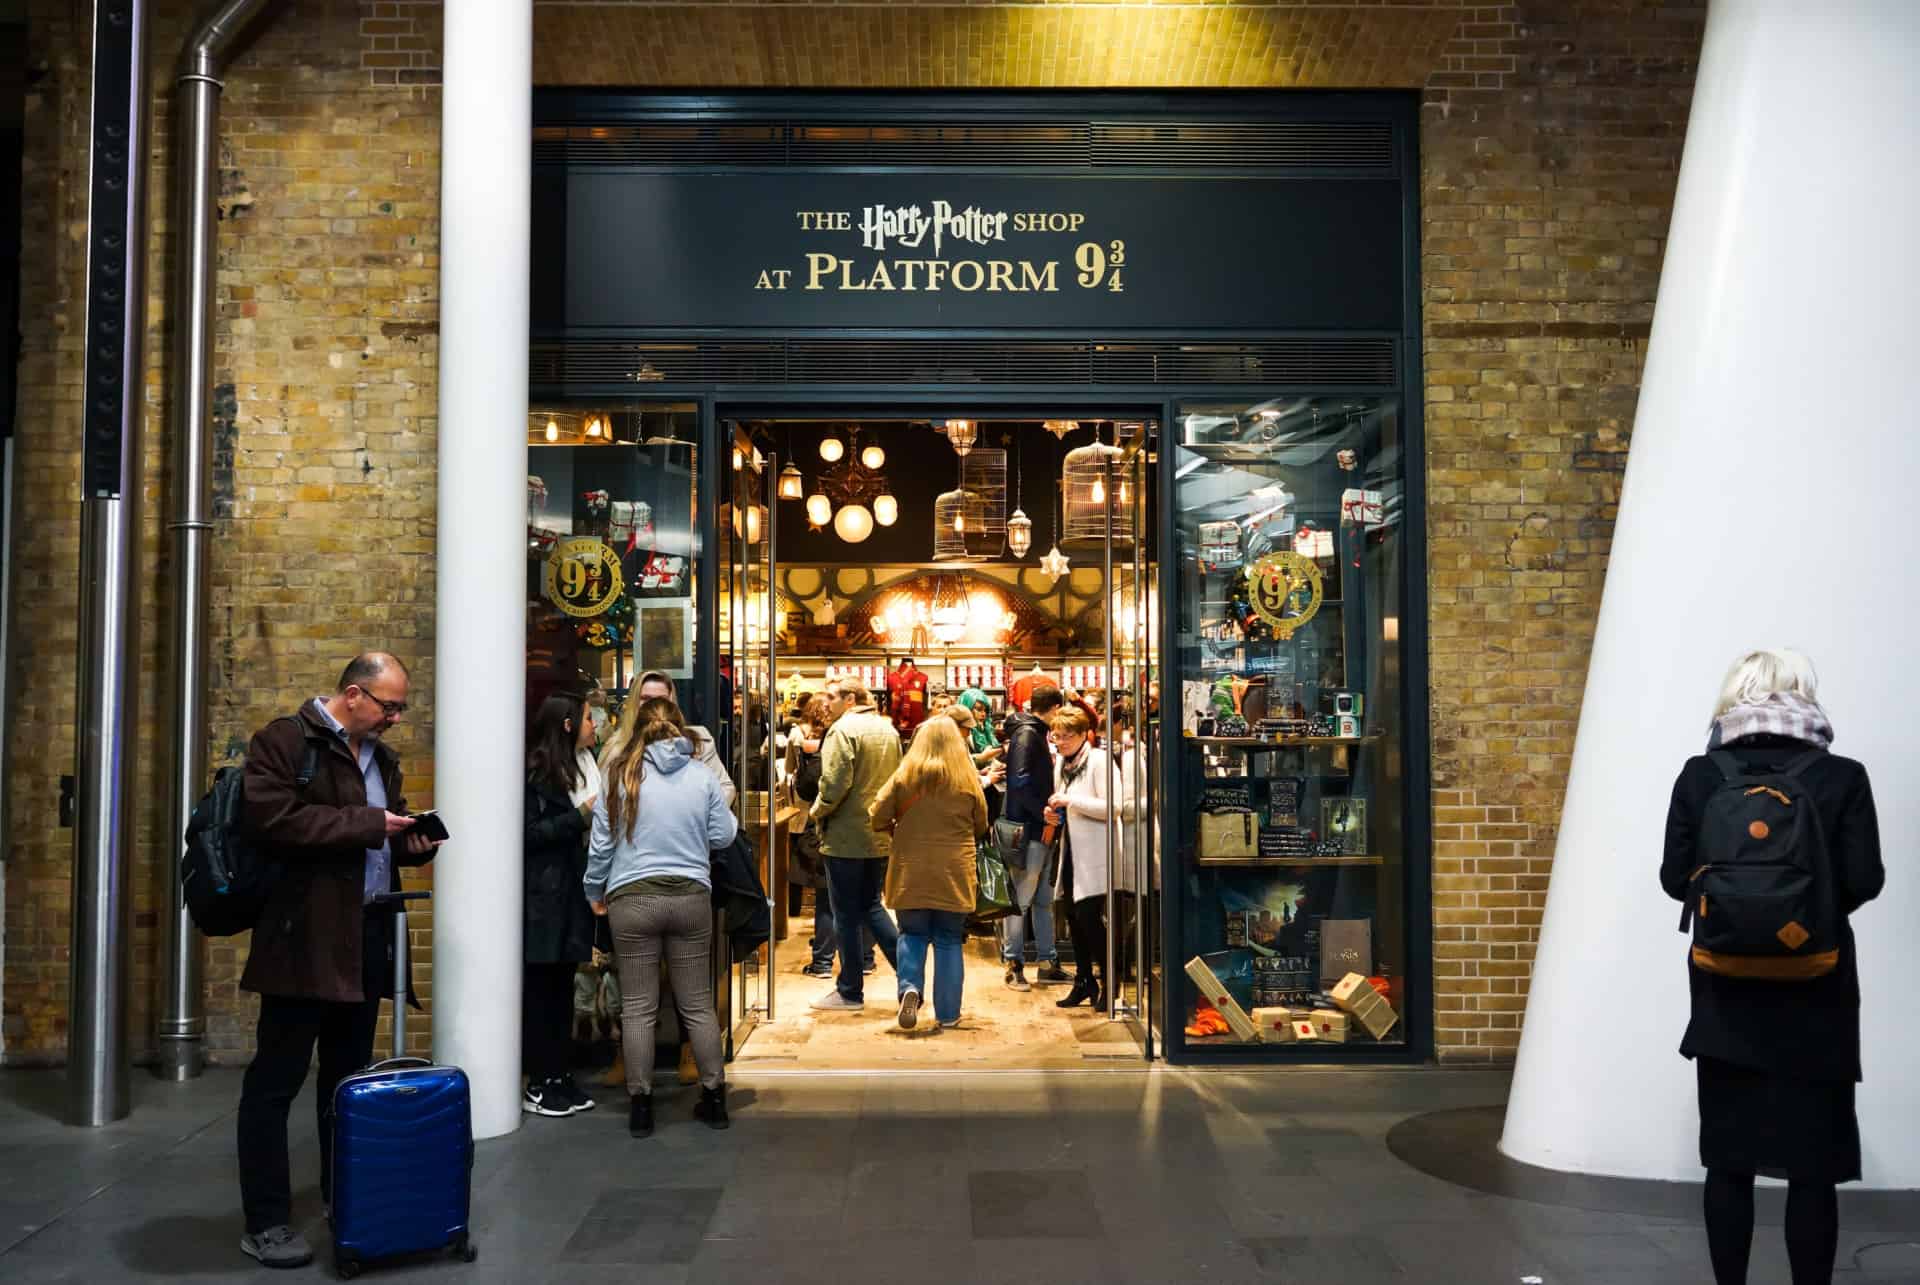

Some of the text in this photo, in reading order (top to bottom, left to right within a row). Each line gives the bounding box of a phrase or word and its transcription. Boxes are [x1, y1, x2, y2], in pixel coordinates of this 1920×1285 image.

[797, 200, 1085, 258] THE Harry Potter SHOP
[754, 270, 791, 290] AT
[804, 253, 1059, 291] PLATFORM
